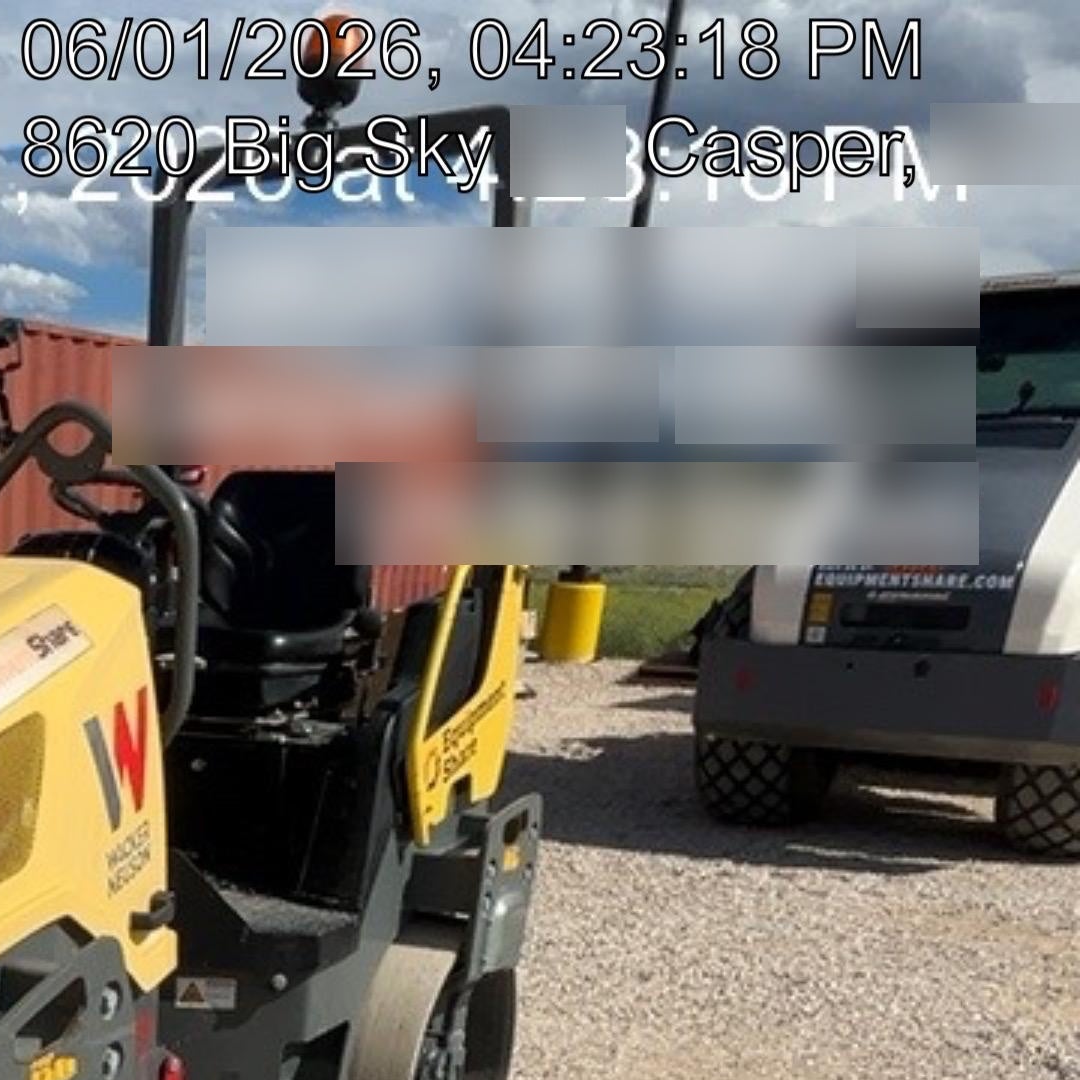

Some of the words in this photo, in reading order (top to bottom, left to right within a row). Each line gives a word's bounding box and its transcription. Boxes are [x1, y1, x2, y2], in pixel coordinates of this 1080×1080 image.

[814, 571, 1016, 589] EQUIPMENTSHARE.COM
[443, 681, 507, 754] Equipment
[443, 737, 478, 783] Share
